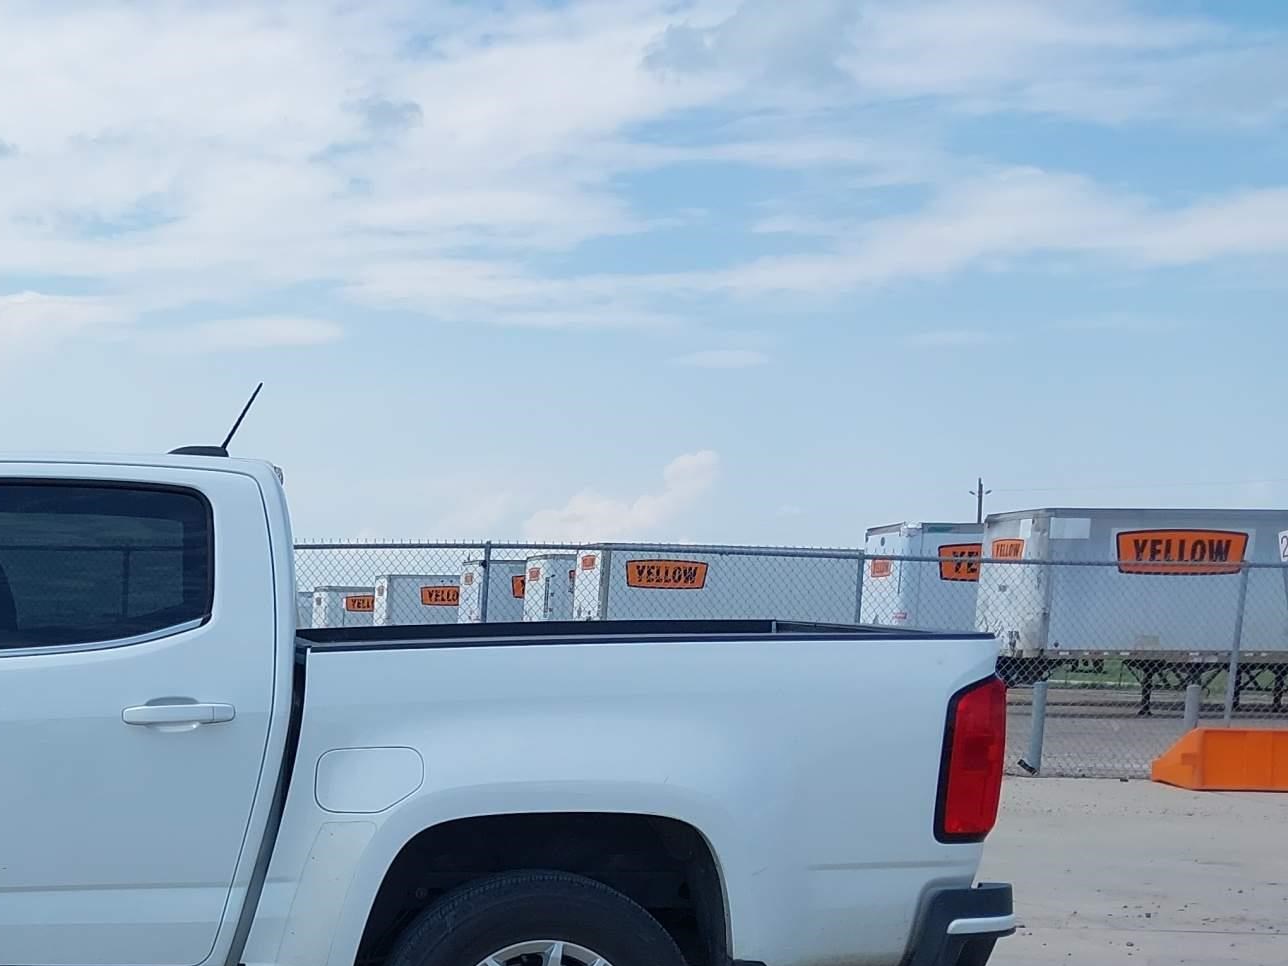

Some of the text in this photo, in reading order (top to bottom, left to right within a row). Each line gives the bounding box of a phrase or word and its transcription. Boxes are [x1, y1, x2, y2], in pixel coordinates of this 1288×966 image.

[995, 543, 1021, 558] YELLOW
[1133, 539, 1232, 562] YELLOW
[635, 565, 698, 584] YELLOW
